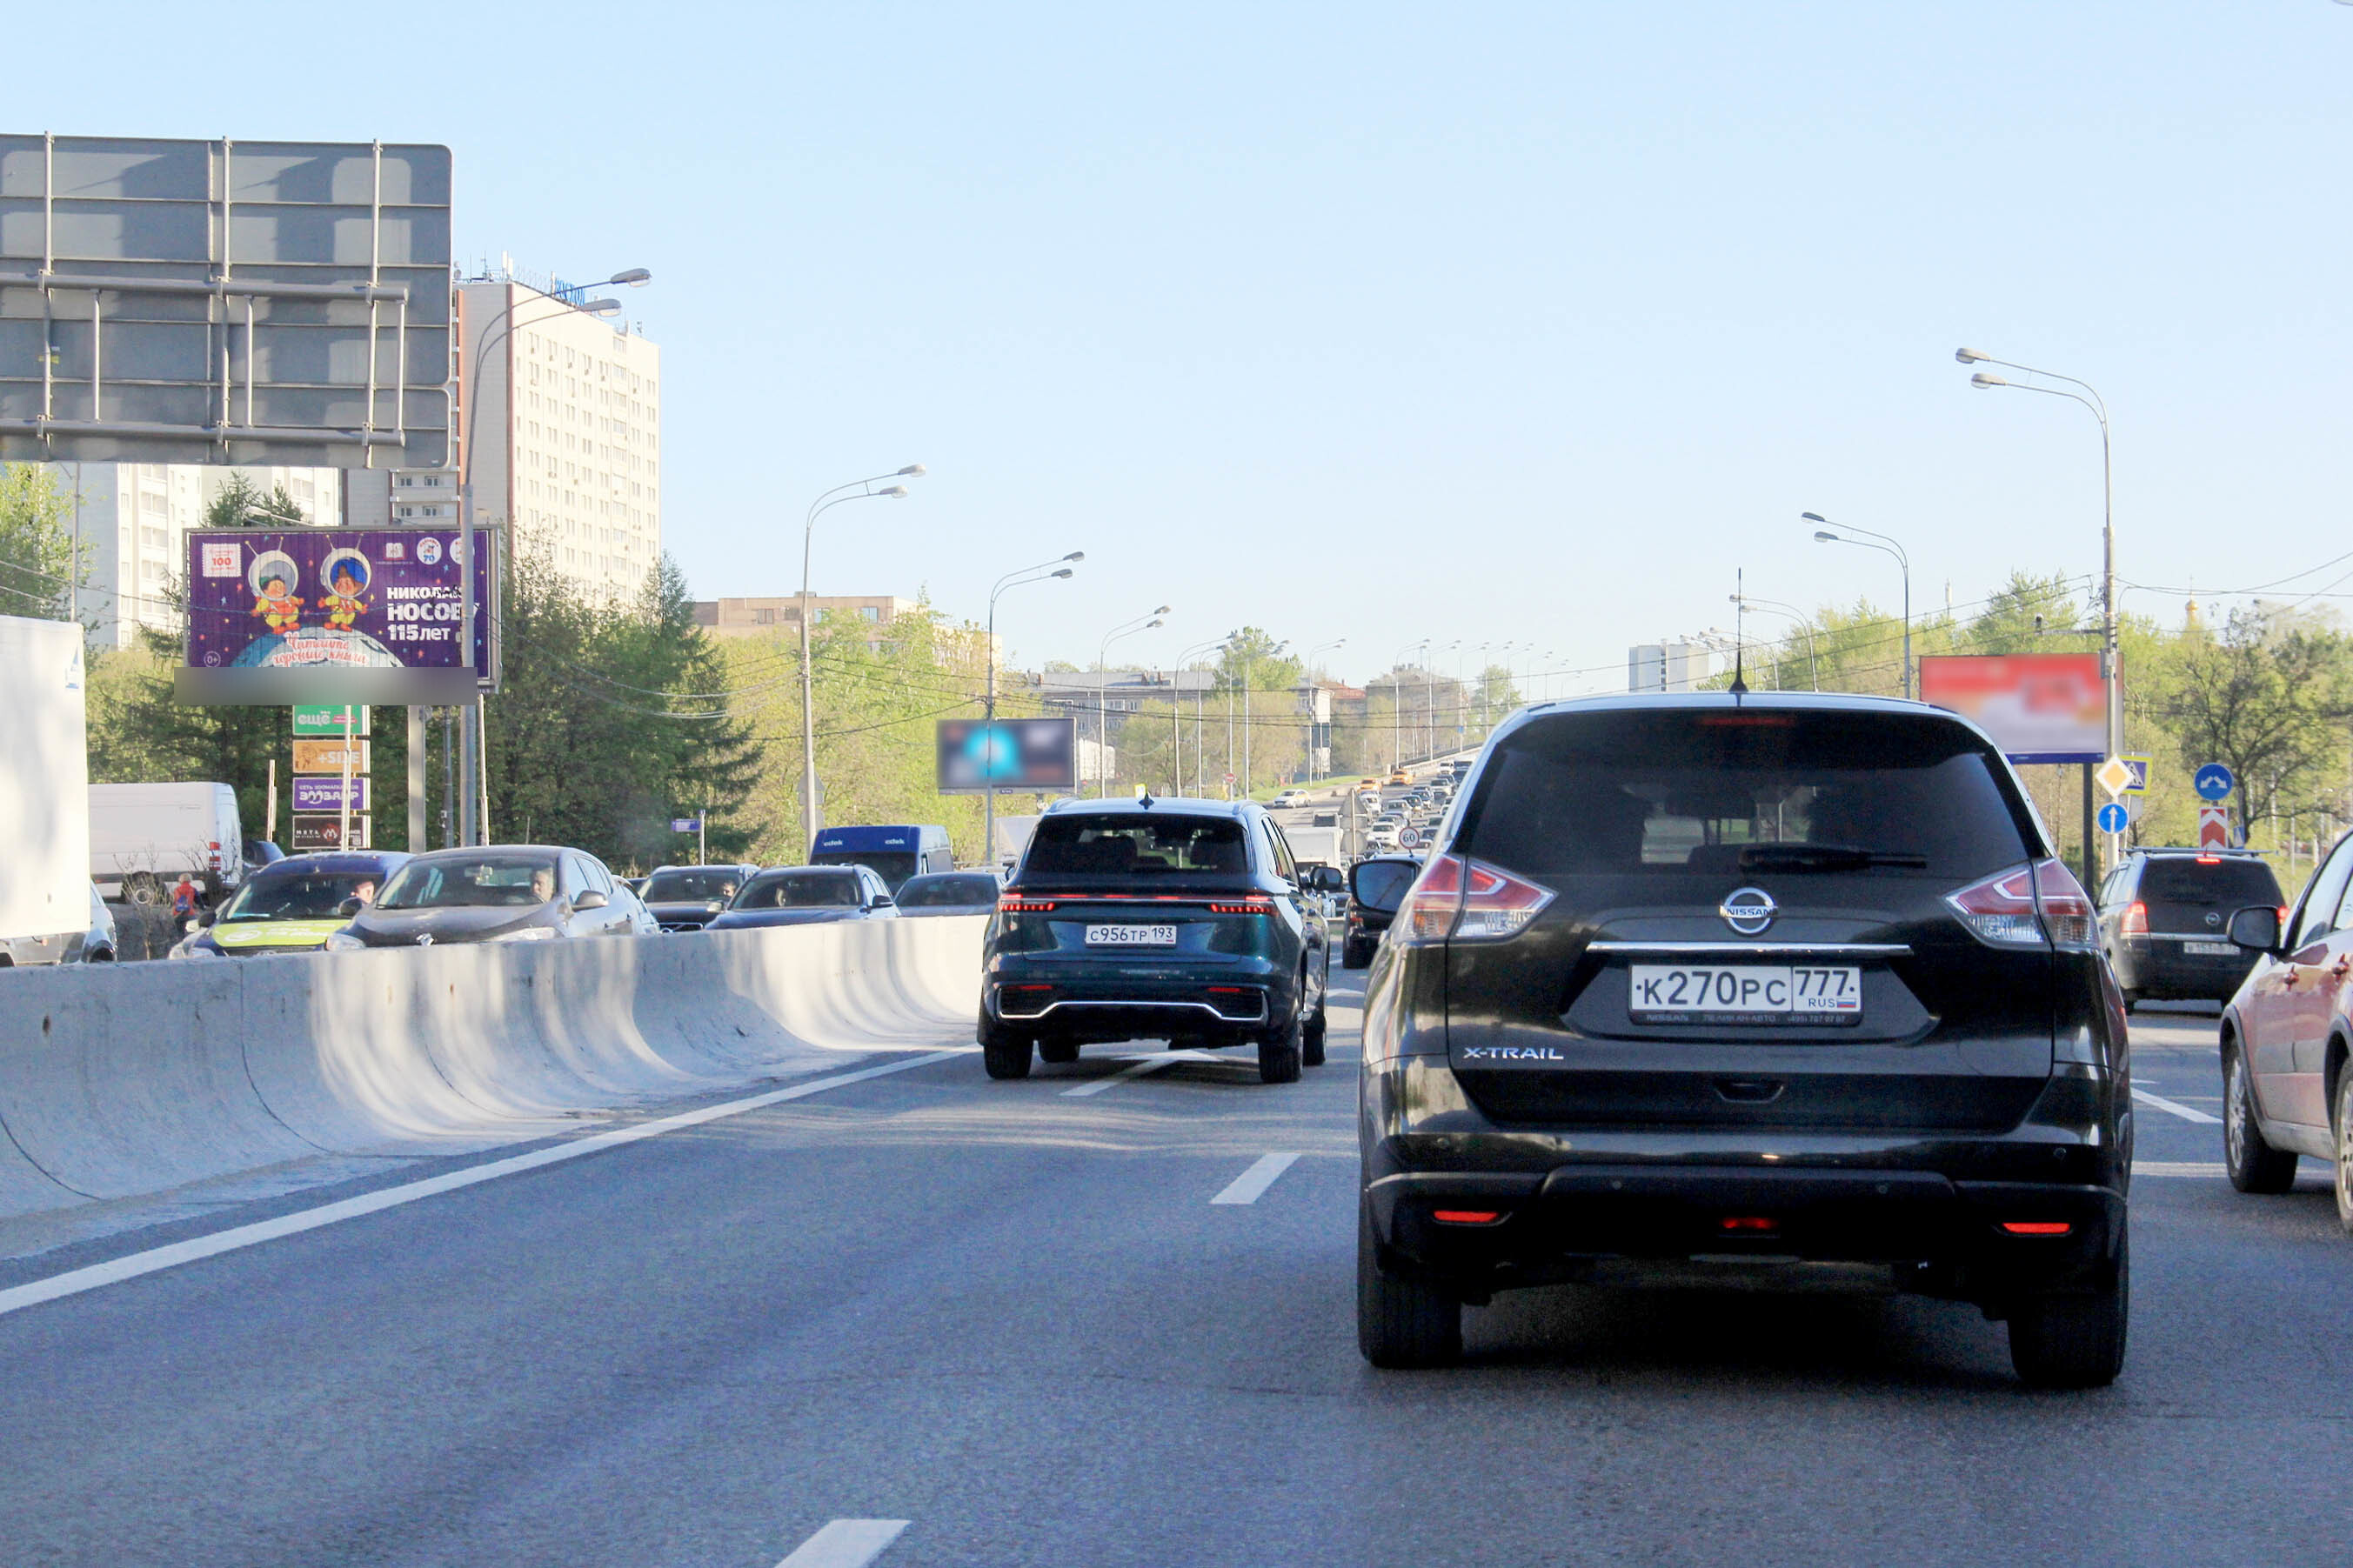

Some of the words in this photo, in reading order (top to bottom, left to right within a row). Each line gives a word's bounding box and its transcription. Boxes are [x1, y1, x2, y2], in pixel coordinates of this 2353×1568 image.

[211, 557, 231, 565] 100
[386, 602, 480, 621] НОСОВ
[207, 656, 218, 664] 0+
[1402, 832, 1416, 843] 60
[1726, 907, 1772, 917] NISSAN
[1642, 971, 1787, 1005] К270РС
[1794, 969, 1850, 997] 777
[1808, 998, 1835, 1008] RUS
[1462, 1046, 1565, 1060] X-TRAIL
